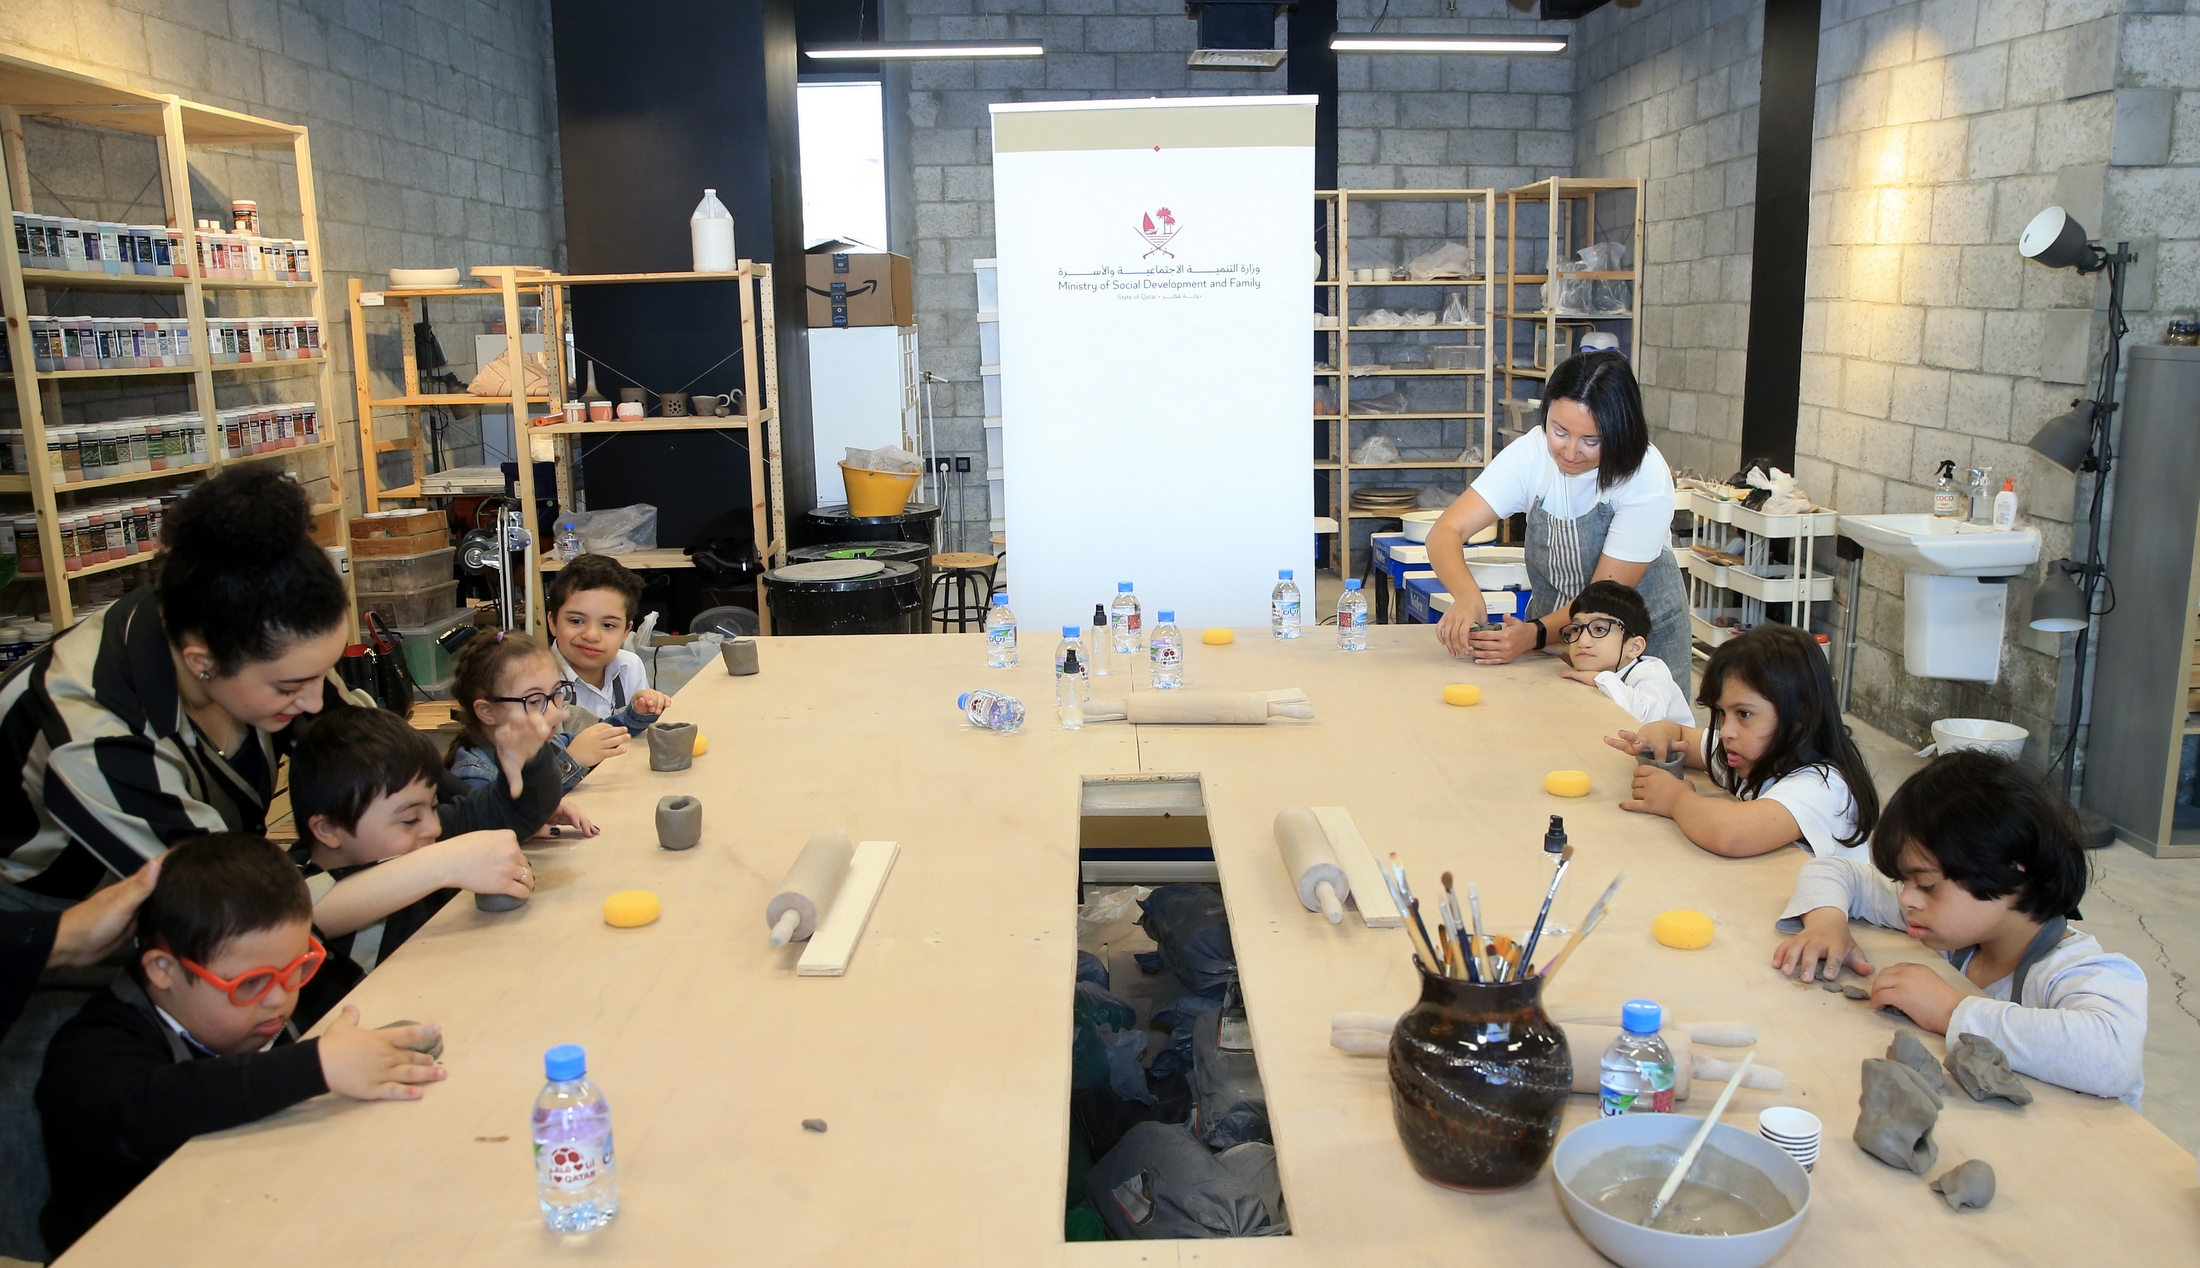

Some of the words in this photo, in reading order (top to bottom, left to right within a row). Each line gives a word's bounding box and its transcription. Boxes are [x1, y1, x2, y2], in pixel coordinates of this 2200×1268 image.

[1117, 264, 1184, 277] الاجتماعية
[1186, 263, 1239, 276] التنمية
[1240, 263, 1261, 275] وزارة
[1058, 281, 1098, 293] Ministry
[1100, 280, 1110, 290] of
[1112, 279, 1141, 290] Social
[1143, 278, 1207, 291] Development
[1209, 278, 1227, 289] and
[1229, 277, 1261, 290] Family
[1140, 293, 1157, 301] Qatar
[565, 1170, 596, 1183] QATAR
